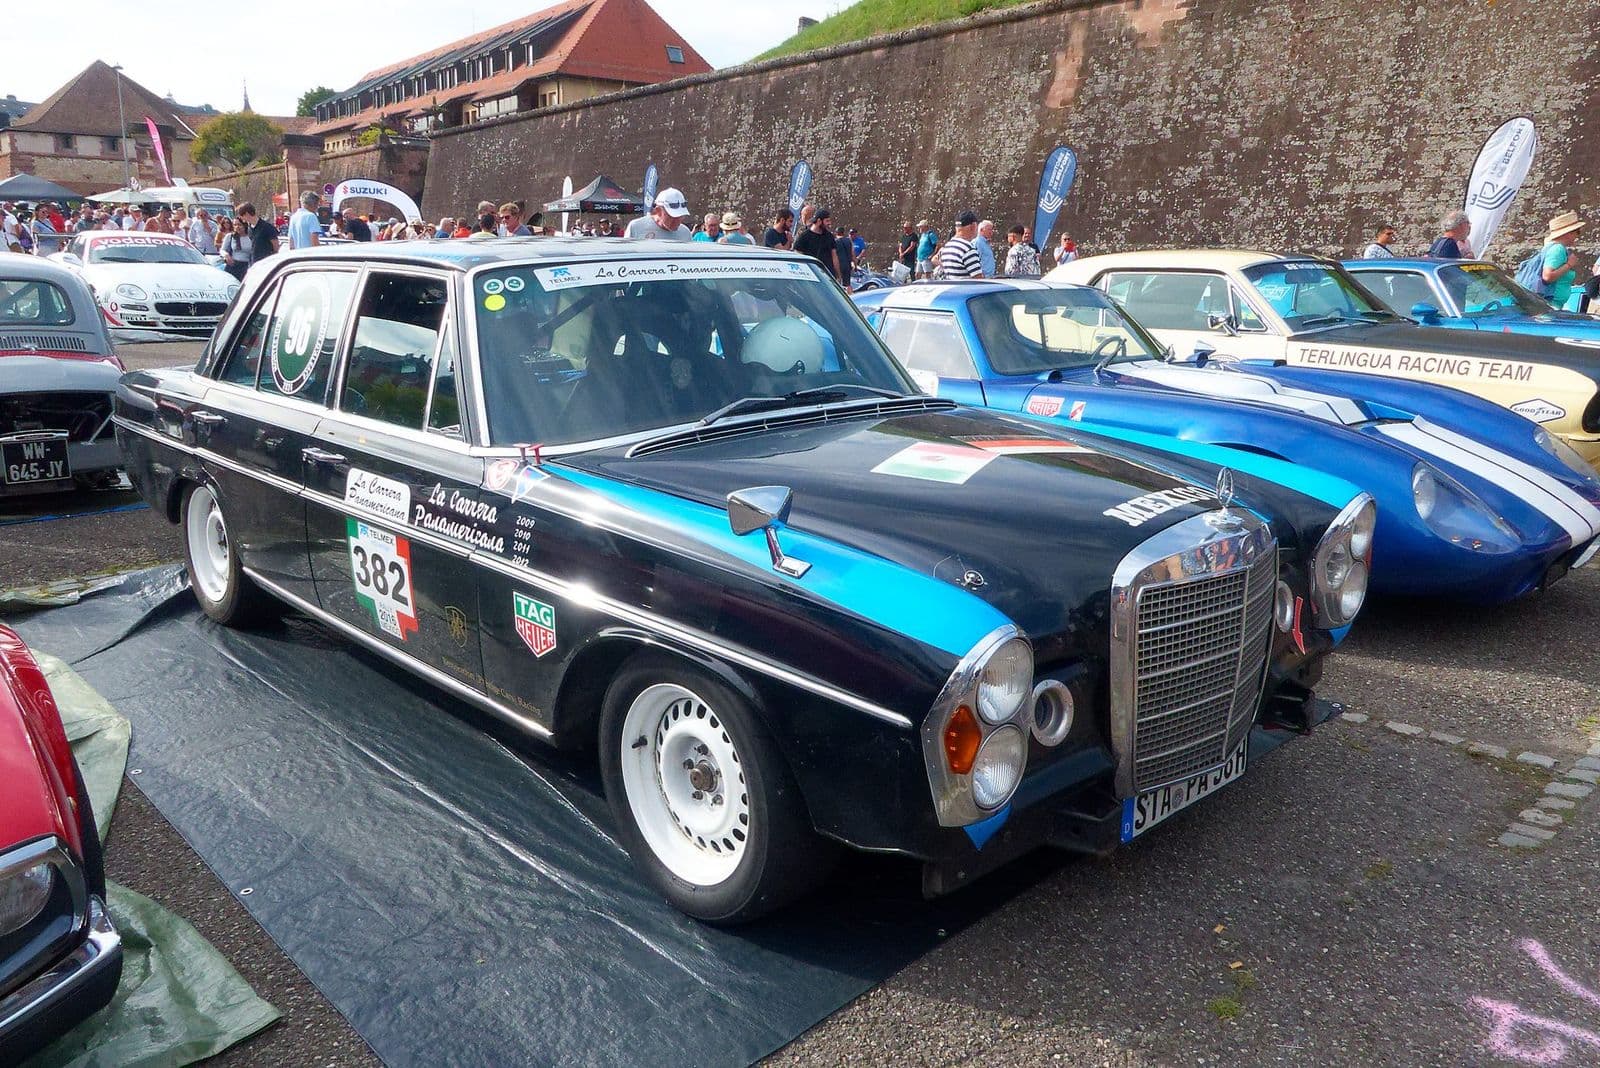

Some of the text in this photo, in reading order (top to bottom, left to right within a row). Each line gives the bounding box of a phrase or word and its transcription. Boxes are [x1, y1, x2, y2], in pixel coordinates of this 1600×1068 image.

[349, 186, 388, 195] SUZUKI
[98, 237, 186, 247] vodafone
[549, 275, 583, 285] TELMEX
[595, 266, 615, 278] La
[617, 265, 663, 278] Carrera
[284, 305, 317, 357] 96
[1299, 348, 1534, 382] TERLINGUA RACING TEAM
[9, 460, 64, 481] 645-JY
[354, 472, 402, 501] La Carrera
[349, 484, 406, 522] Panamericana
[428, 482, 498, 524] La Carrera
[1102, 486, 1219, 527] MEXICO
[414, 504, 505, 554] Panamericana
[514, 528, 532, 541] 2010
[516, 515, 536, 529] 2009
[369, 530, 395, 546] TELMEX
[512, 540, 531, 554] 2011
[511, 554, 530, 568] 2012
[353, 545, 409, 607] 382
[518, 597, 553, 628] TAG
[517, 618, 555, 654] HEUER
[1135, 786, 1171, 830] STA
[1124, 821, 1131, 834] D
